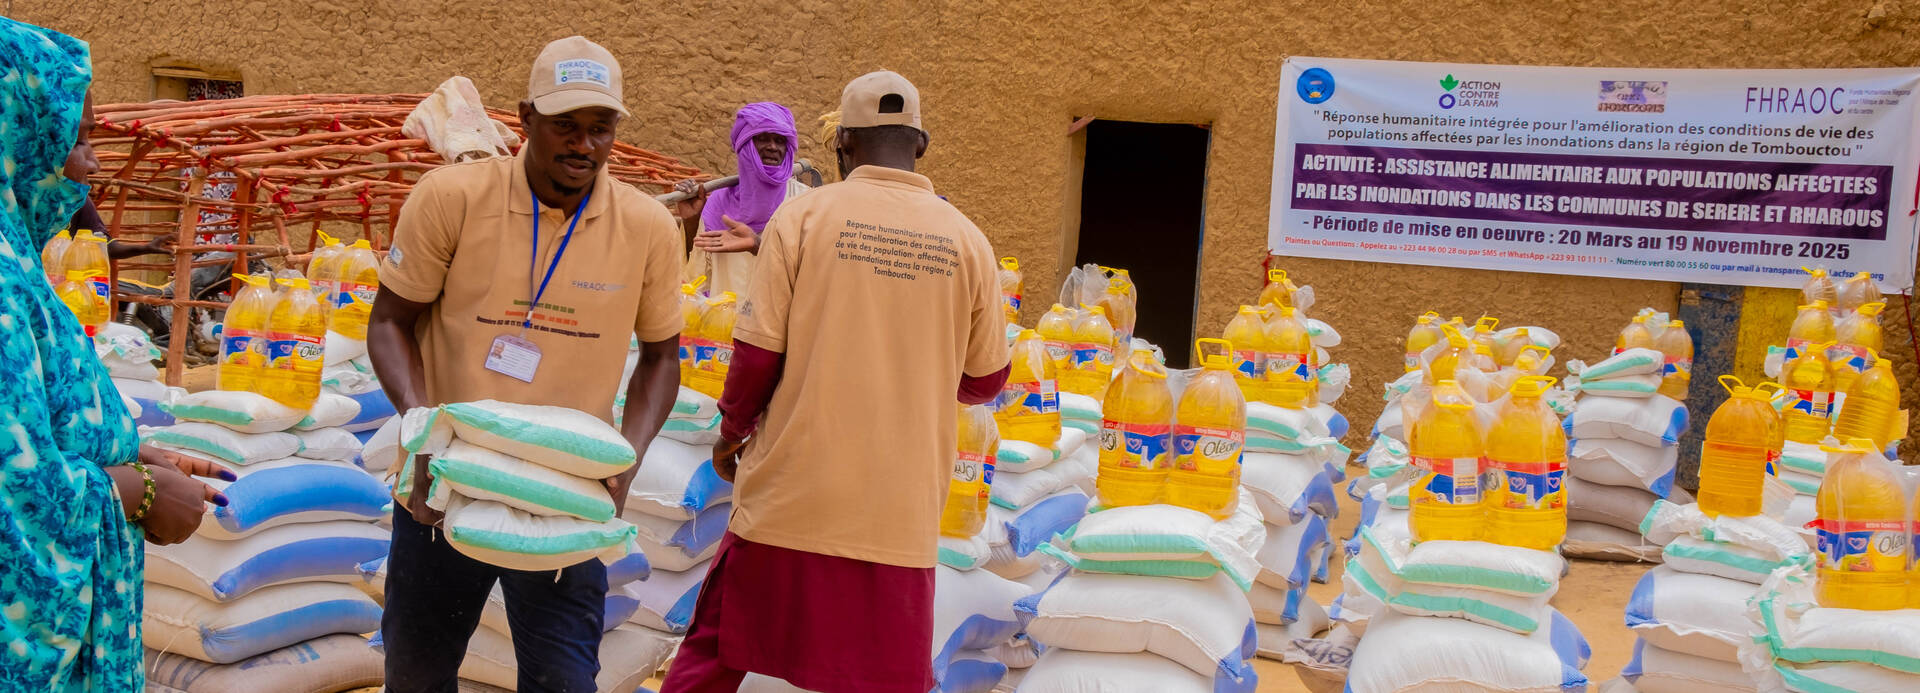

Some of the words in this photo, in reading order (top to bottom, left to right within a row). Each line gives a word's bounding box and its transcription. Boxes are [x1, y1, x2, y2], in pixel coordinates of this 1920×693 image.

[1459, 80, 1501, 90] ACTION
[1459, 90, 1500, 100] CONTRE
[1459, 98, 1471, 108] LA
[1473, 99, 1499, 108] FAIM
[1745, 87, 1845, 115] FHRAOC
[1322, 110, 1379, 127] Réponse
[1383, 113, 1466, 127] humanitaire
[1469, 116, 1529, 132] intégrée
[1533, 120, 1567, 132] pour
[1571, 119, 1674, 135] l'amélioration
[1679, 123, 1704, 135] des
[1709, 124, 1791, 137] conditions
[1795, 125, 1815, 138] de
[1819, 126, 1842, 139] vie
[1847, 126, 1874, 139] des
[1328, 128, 1408, 142] populations
[1411, 130, 1473, 144] affectées
[1476, 135, 1500, 147] par
[1503, 134, 1522, 146] les
[1526, 135, 1614, 150] inondations
[1618, 136, 1653, 150] dans
[1658, 138, 1670, 151] la
[1674, 139, 1725, 155] région
[1729, 140, 1748, 153] de
[1752, 141, 1851, 156] Tombouctou
[1302, 154, 1376, 173] ACTIVITE
[1384, 158, 1488, 179] ASSISTANCE
[1490, 162, 1603, 184] ALIMENTAIRE
[1605, 167, 1643, 186] AUX
[1646, 168, 1772, 191] POPULATIONS
[1775, 174, 1878, 194] AFFECTEES
[1296, 182, 1327, 200] PAR
[1329, 184, 1357, 202] LES
[1360, 186, 1471, 208] INONDATIONS
[1474, 192, 1521, 211] DANS
[1524, 194, 1554, 212] LES
[1557, 196, 1662, 218] COMMUNES
[1665, 201, 1689, 219] DE
[1692, 202, 1761, 222] SERERE
[1764, 205, 1787, 223] ET
[1789, 206, 1884, 228] RHAROUS
[840, 231, 857, 240] pour
[910, 240, 923, 250] des
[924, 242, 958, 258] conditions
[878, 223, 923, 240] humanitaire
[1313, 215, 1379, 233] Période
[1383, 219, 1404, 234] de
[1408, 222, 1451, 237] mise
[1456, 226, 1478, 240] en
[1482, 227, 1545, 243] oeuvre
[1558, 229, 1581, 246] 20
[1586, 231, 1633, 249] Mars
[1637, 235, 1661, 250] au
[1666, 235, 1687, 251] 19
[1692, 236, 1794, 257] Novembre
[1798, 241, 1850, 260] 2025
[835, 240, 845, 249] de
[847, 241, 858, 250] vie
[859, 243, 872, 252] des
[1285, 236, 1311, 245] Plaintes
[1322, 239, 1355, 248] Questions
[1360, 241, 1387, 251] Appelez
[1468, 249, 1481, 258] par
[1482, 249, 1497, 257] SMS
[1508, 250, 1545, 261] WhatsApp
[1566, 254, 1575, 262] 93
[1577, 255, 1585, 263] 10
[1588, 255, 1596, 263] 11
[1599, 256, 1607, 264] 11
[1616, 257, 1647, 266] Numéro
[1649, 259, 1664, 267] vert
[1665, 260, 1675, 268] 80
[1676, 260, 1686, 269] 00
[1688, 261, 1697, 269] 55
[1721, 264, 1735, 273] par
[1737, 263, 1754, 273] mail
[838, 251, 849, 260] les
[850, 252, 892, 267] inondations
[893, 257, 911, 270] dans
[913, 262, 921, 271] la
[946, 269, 953, 277] d
[873, 266, 916, 281] Tombouctou
